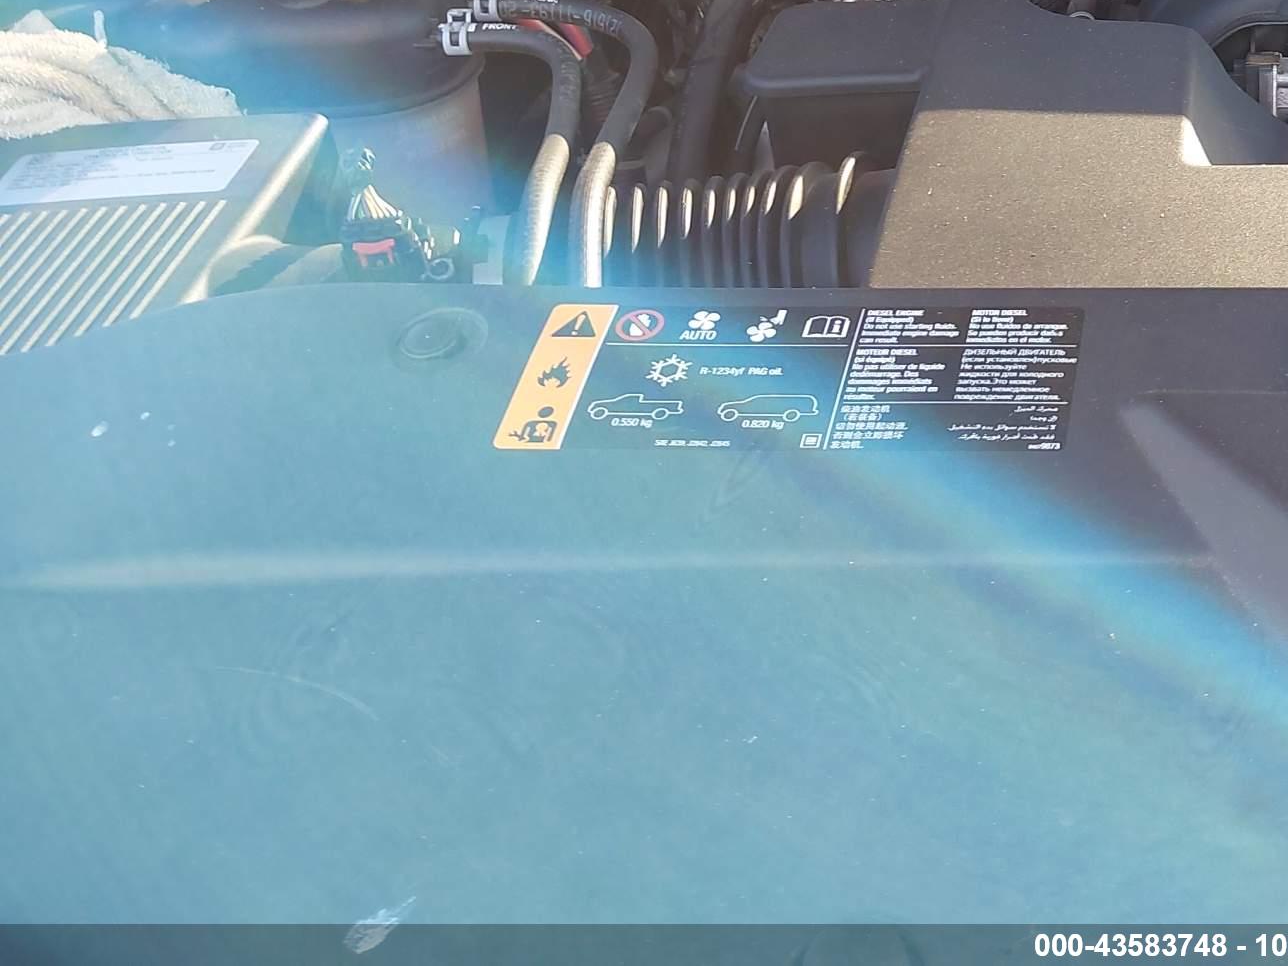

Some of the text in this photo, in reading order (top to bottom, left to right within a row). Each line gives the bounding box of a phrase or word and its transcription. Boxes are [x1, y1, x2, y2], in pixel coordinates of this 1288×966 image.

[680, 330, 717, 341] AUTO
[748, 367, 768, 376] PAG
[612, 418, 653, 429] 0.550 kg
[742, 420, 785, 430] 0.820 kg
